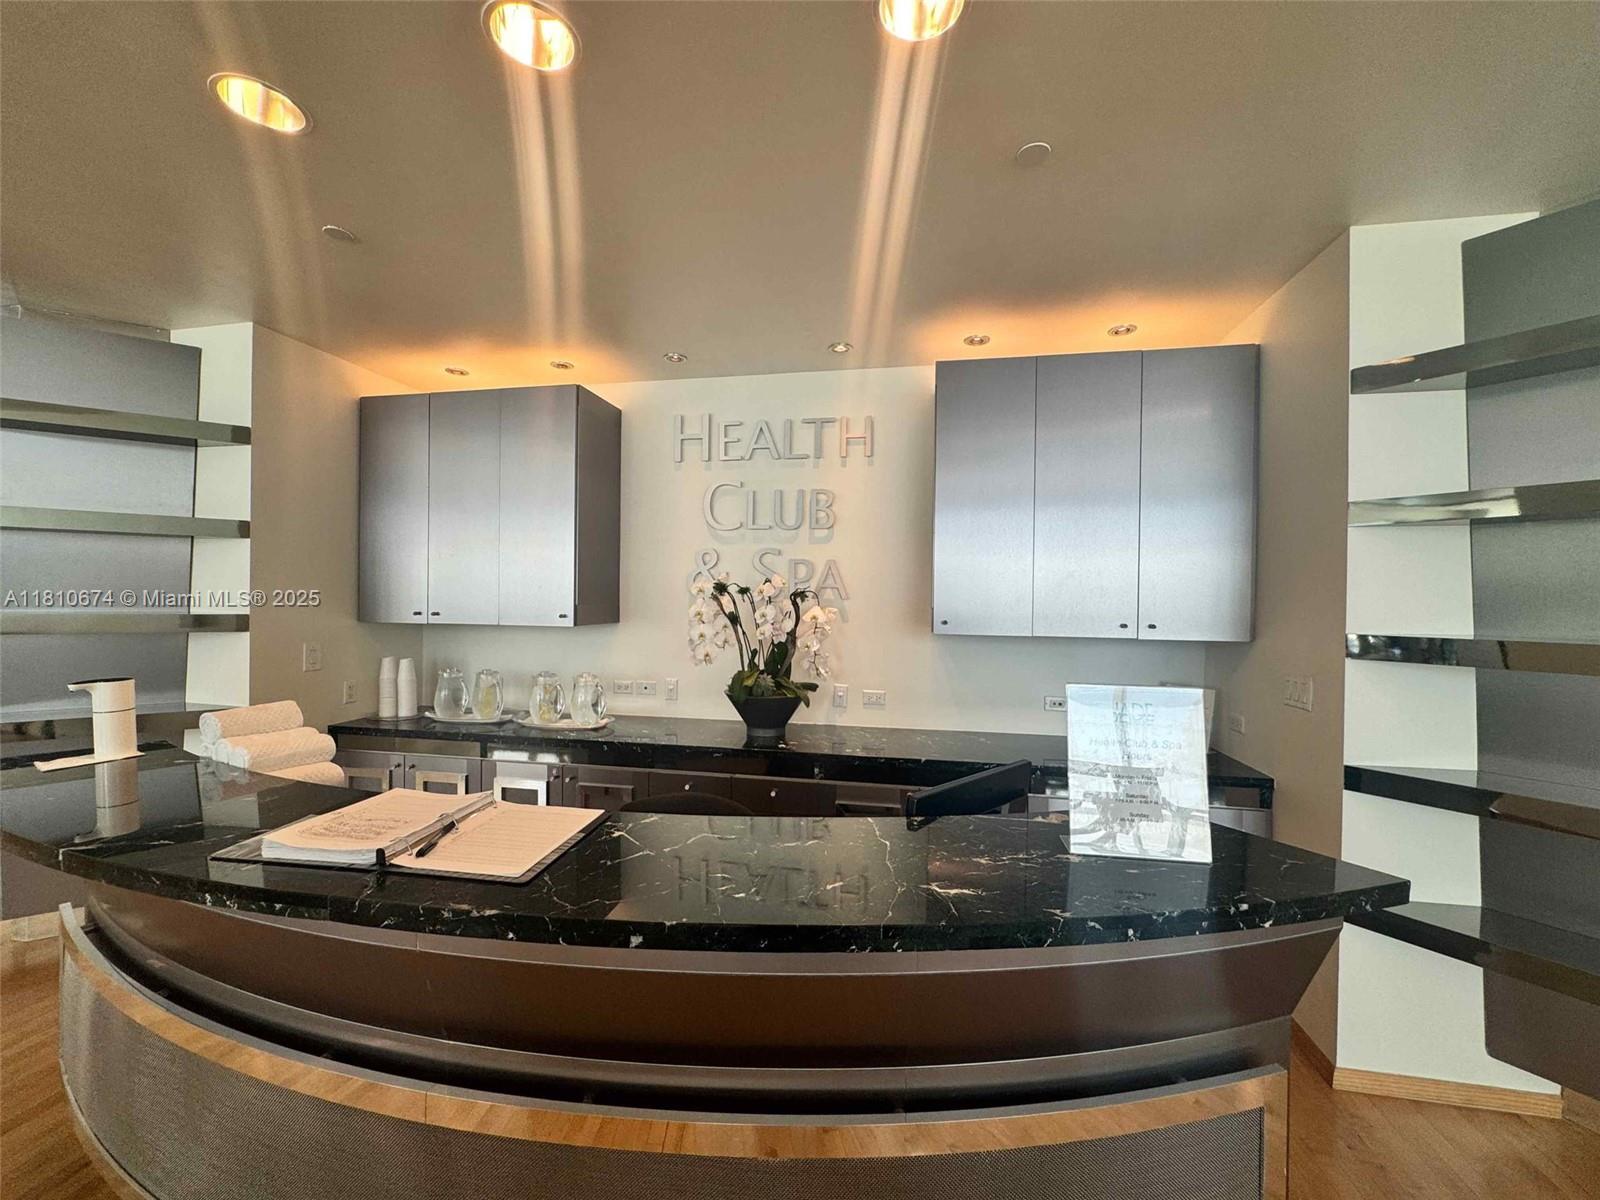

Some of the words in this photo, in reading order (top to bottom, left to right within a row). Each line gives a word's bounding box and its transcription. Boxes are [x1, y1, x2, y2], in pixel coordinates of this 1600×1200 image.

[674, 413, 874, 464] HEALTH
[703, 480, 836, 532] CLUB
[752, 548, 850, 601] SPA
[1161, 740, 1183, 752] Spa
